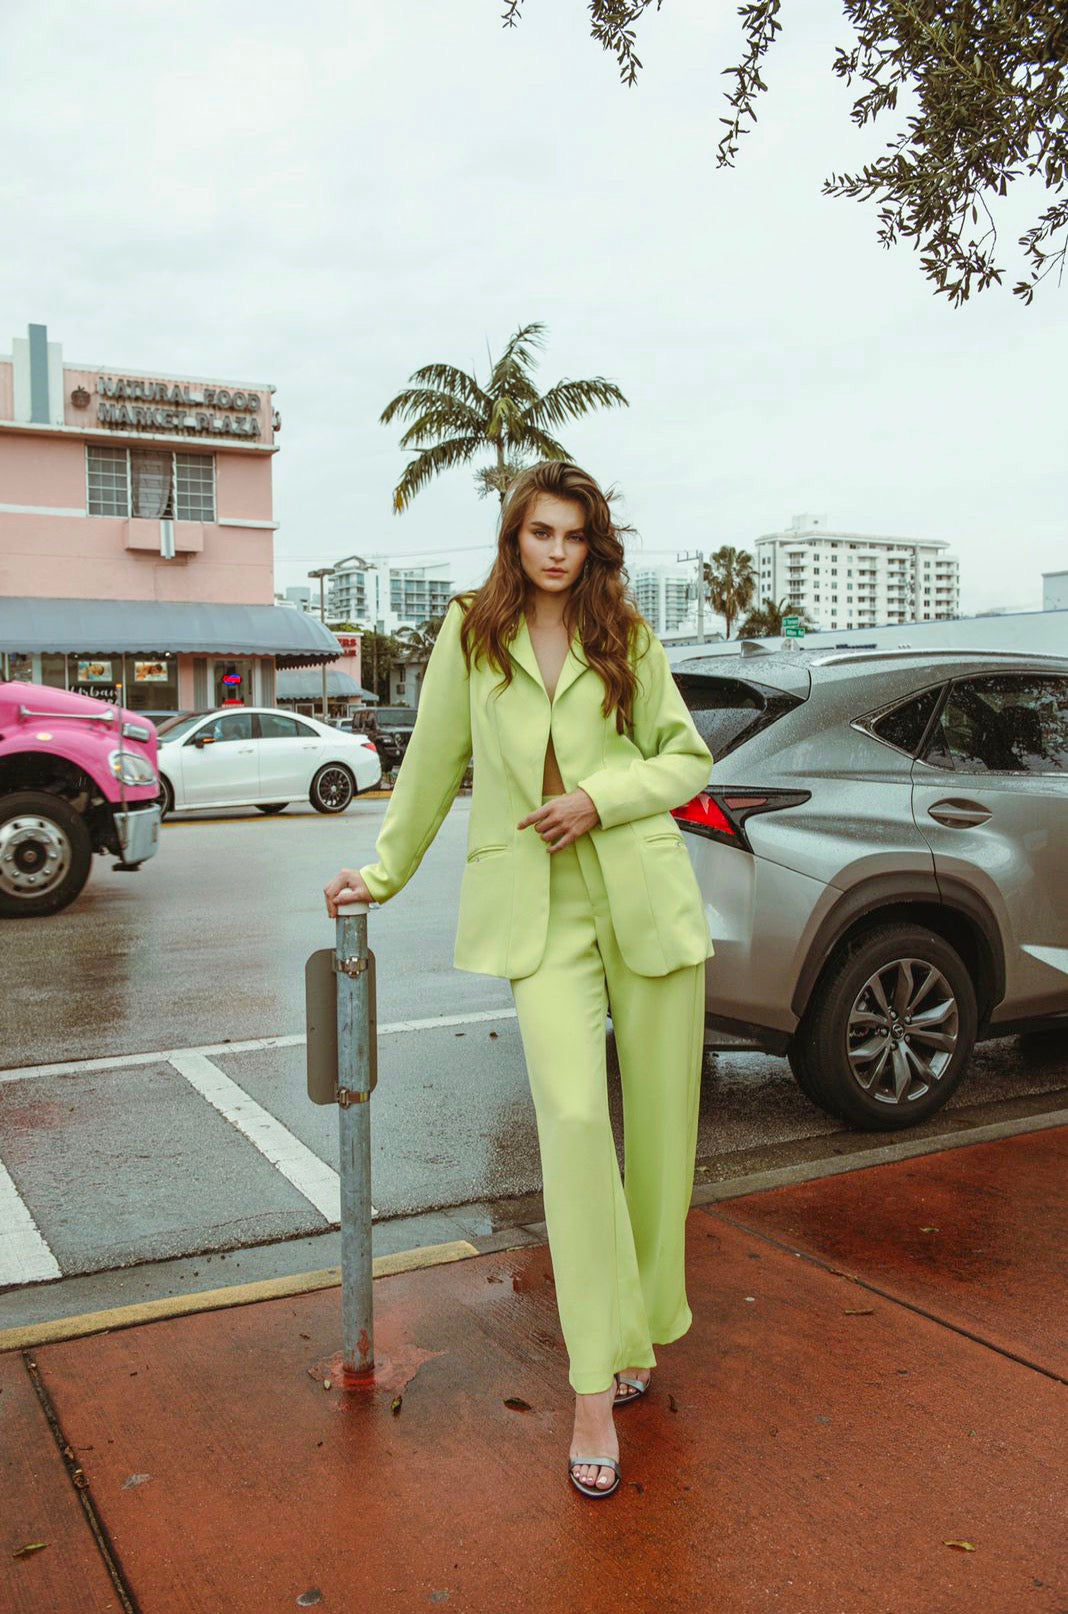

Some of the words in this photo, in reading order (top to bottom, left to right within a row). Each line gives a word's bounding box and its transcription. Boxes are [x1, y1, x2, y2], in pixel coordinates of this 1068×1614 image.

[98, 377, 197, 404] NATURAL
[203, 388, 261, 412] FOOD
[98, 403, 188, 428] MARKET
[195, 412, 261, 436] PLAZA
